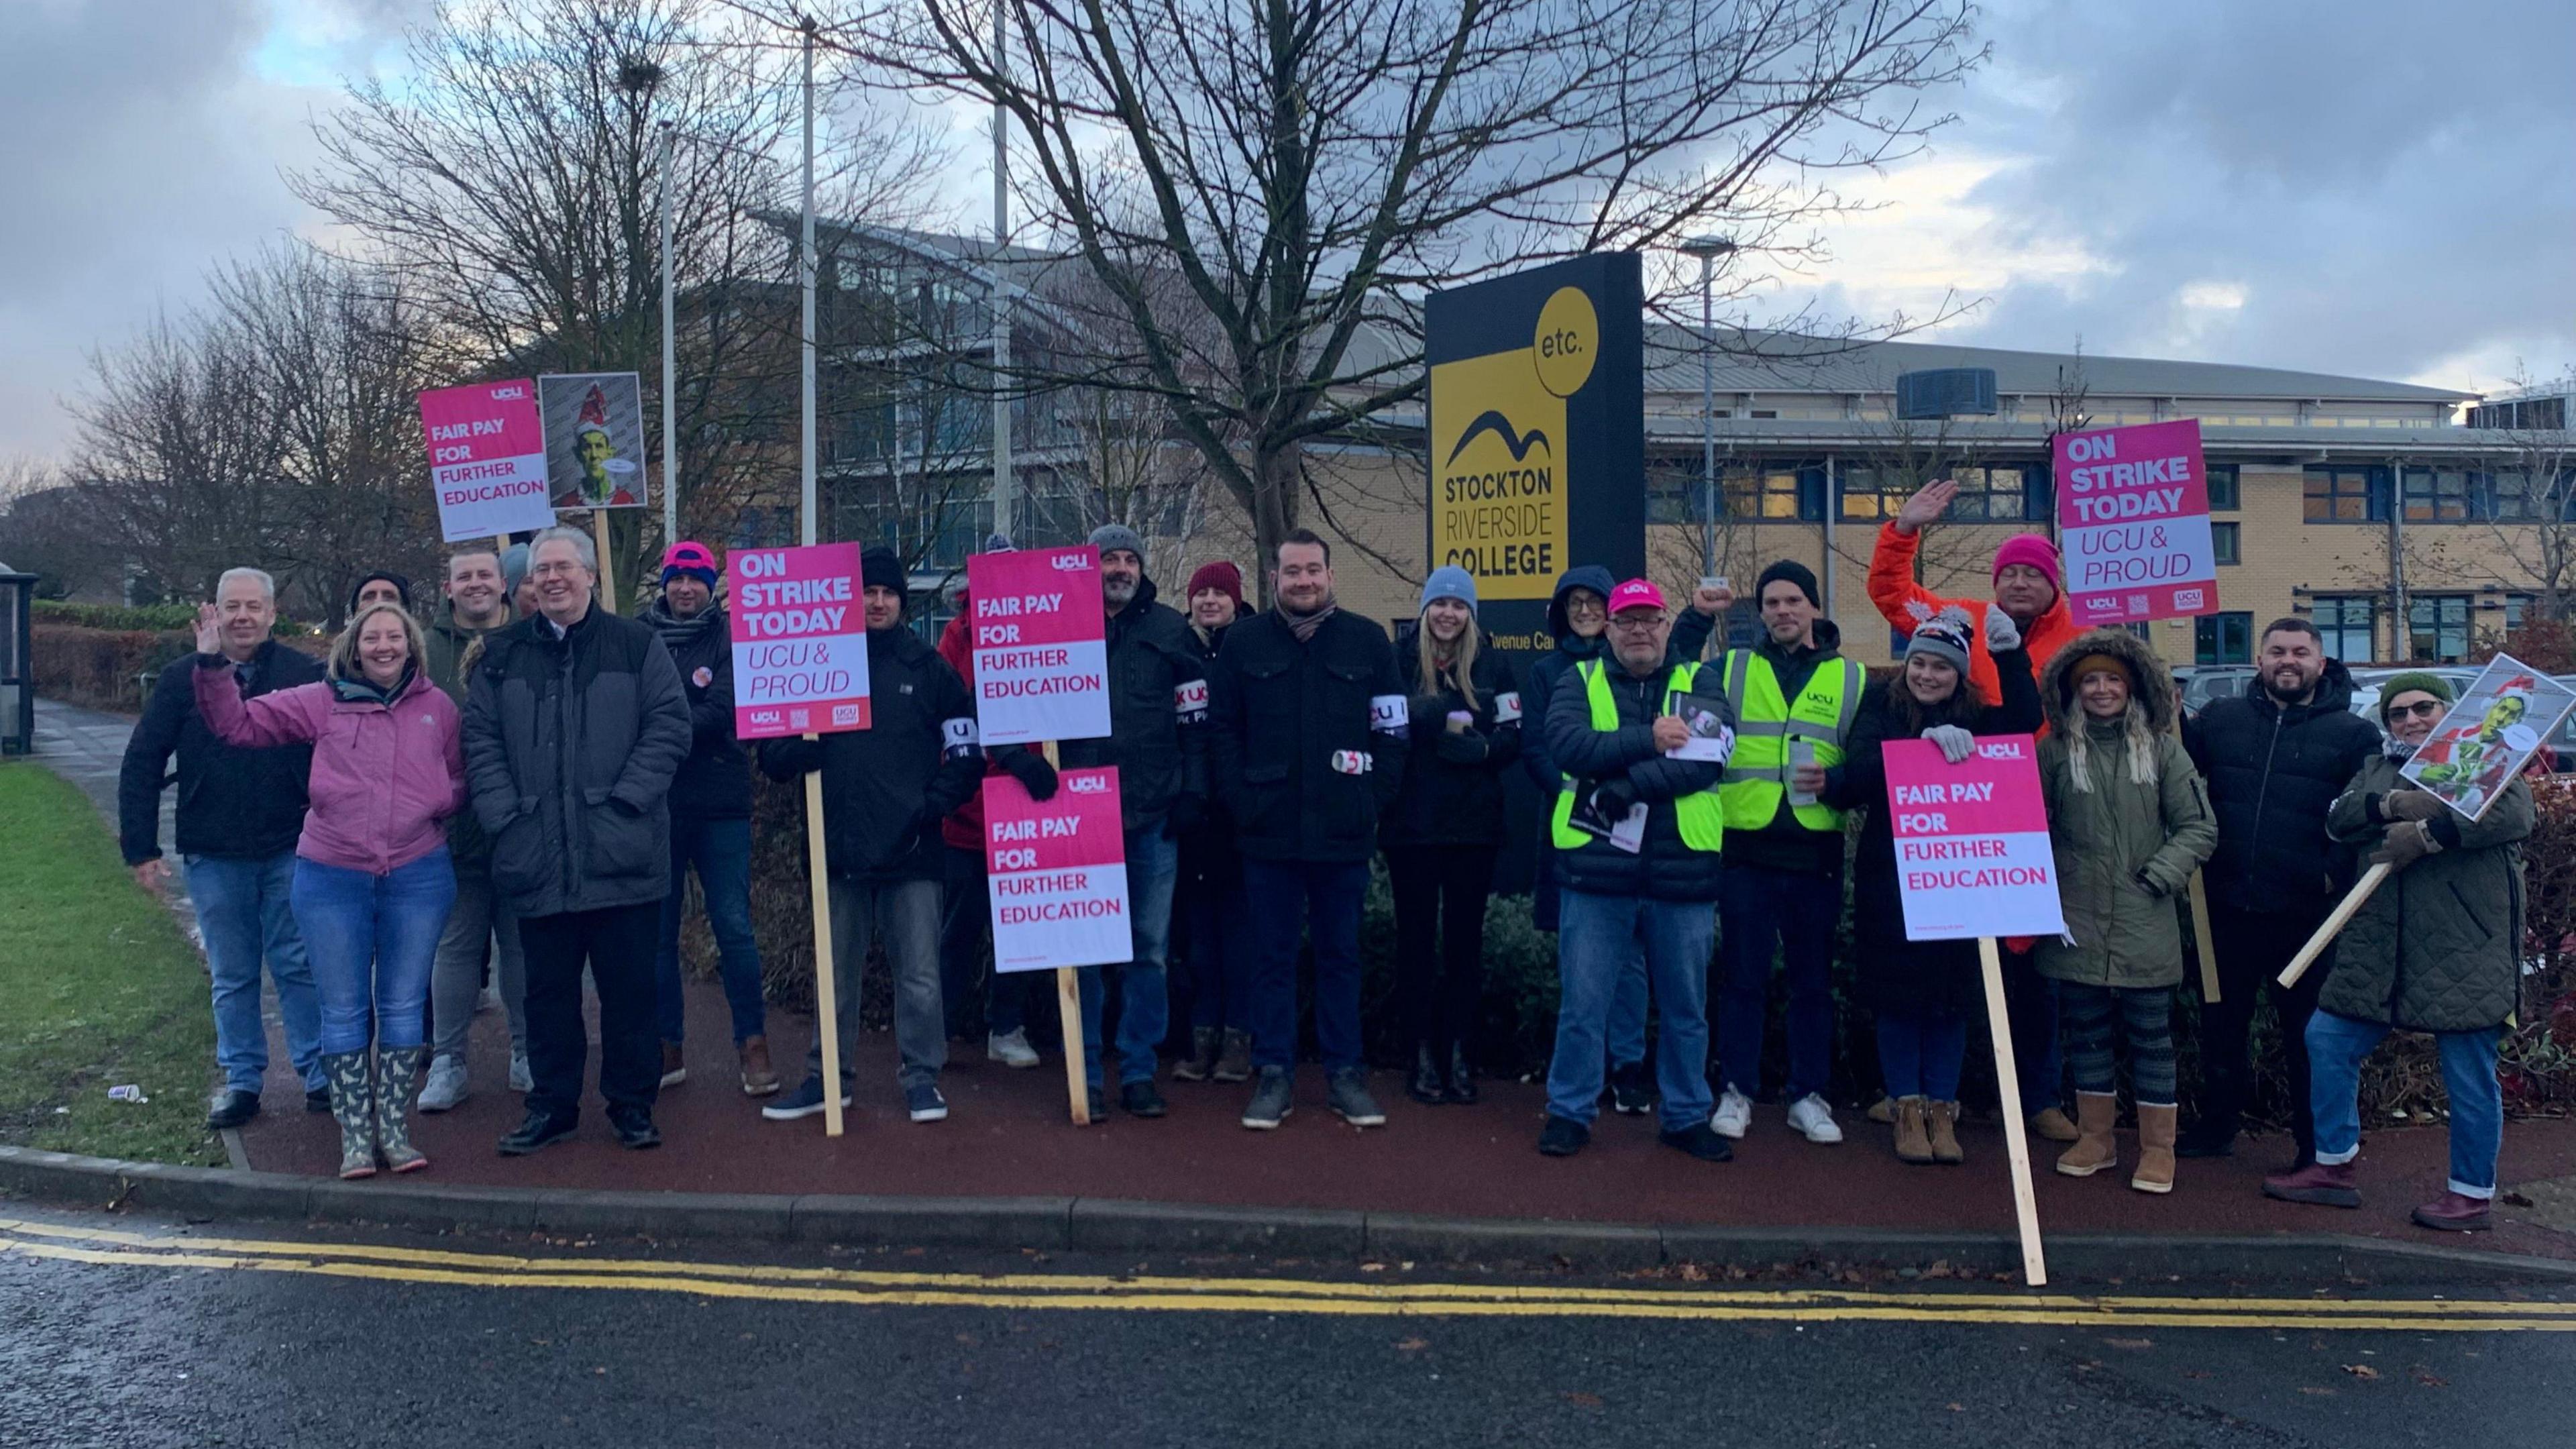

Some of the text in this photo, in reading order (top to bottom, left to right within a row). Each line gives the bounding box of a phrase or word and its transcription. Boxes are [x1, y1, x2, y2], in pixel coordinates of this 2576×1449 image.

[1542, 327, 1582, 358] etc.
[431, 418, 505, 441] FAIR PAY
[435, 445, 472, 463] FOR
[2067, 434, 2116, 462] ON
[439, 462, 517, 484] FURTHER
[1446, 467, 1552, 504] STOCKTON
[2070, 456, 2190, 493] STRIKE
[443, 479, 545, 506] EDUCATION
[2072, 487, 2184, 522] TODAY
[1446, 502, 1553, 541] RIVERSIDE
[2082, 525, 2168, 555] UCU &
[739, 552, 786, 578] ON
[1446, 543, 1553, 577] COLLEGE
[2084, 553, 2192, 586] PROUD
[741, 576, 853, 608] STRIKE
[977, 593, 1064, 618] FAIR PAY
[742, 606, 847, 637] TODAY
[978, 624, 1020, 645] FOR
[749, 642, 830, 669] UCU &
[981, 649, 1069, 672] FURTHER
[749, 670, 850, 700] PROUD
[983, 674, 1101, 699] EDUCATION
[1895, 782, 1994, 806] FAIR PAY
[992, 815, 1081, 843] FAIR PAY
[1898, 812, 1949, 833] FOR
[994, 848, 1038, 870] FOR
[1903, 839, 2007, 861] FURTHER
[998, 873, 1089, 896] FURTHER
[1908, 866, 2048, 891] EDUCATION
[1000, 898, 1122, 924] EDUCATION
